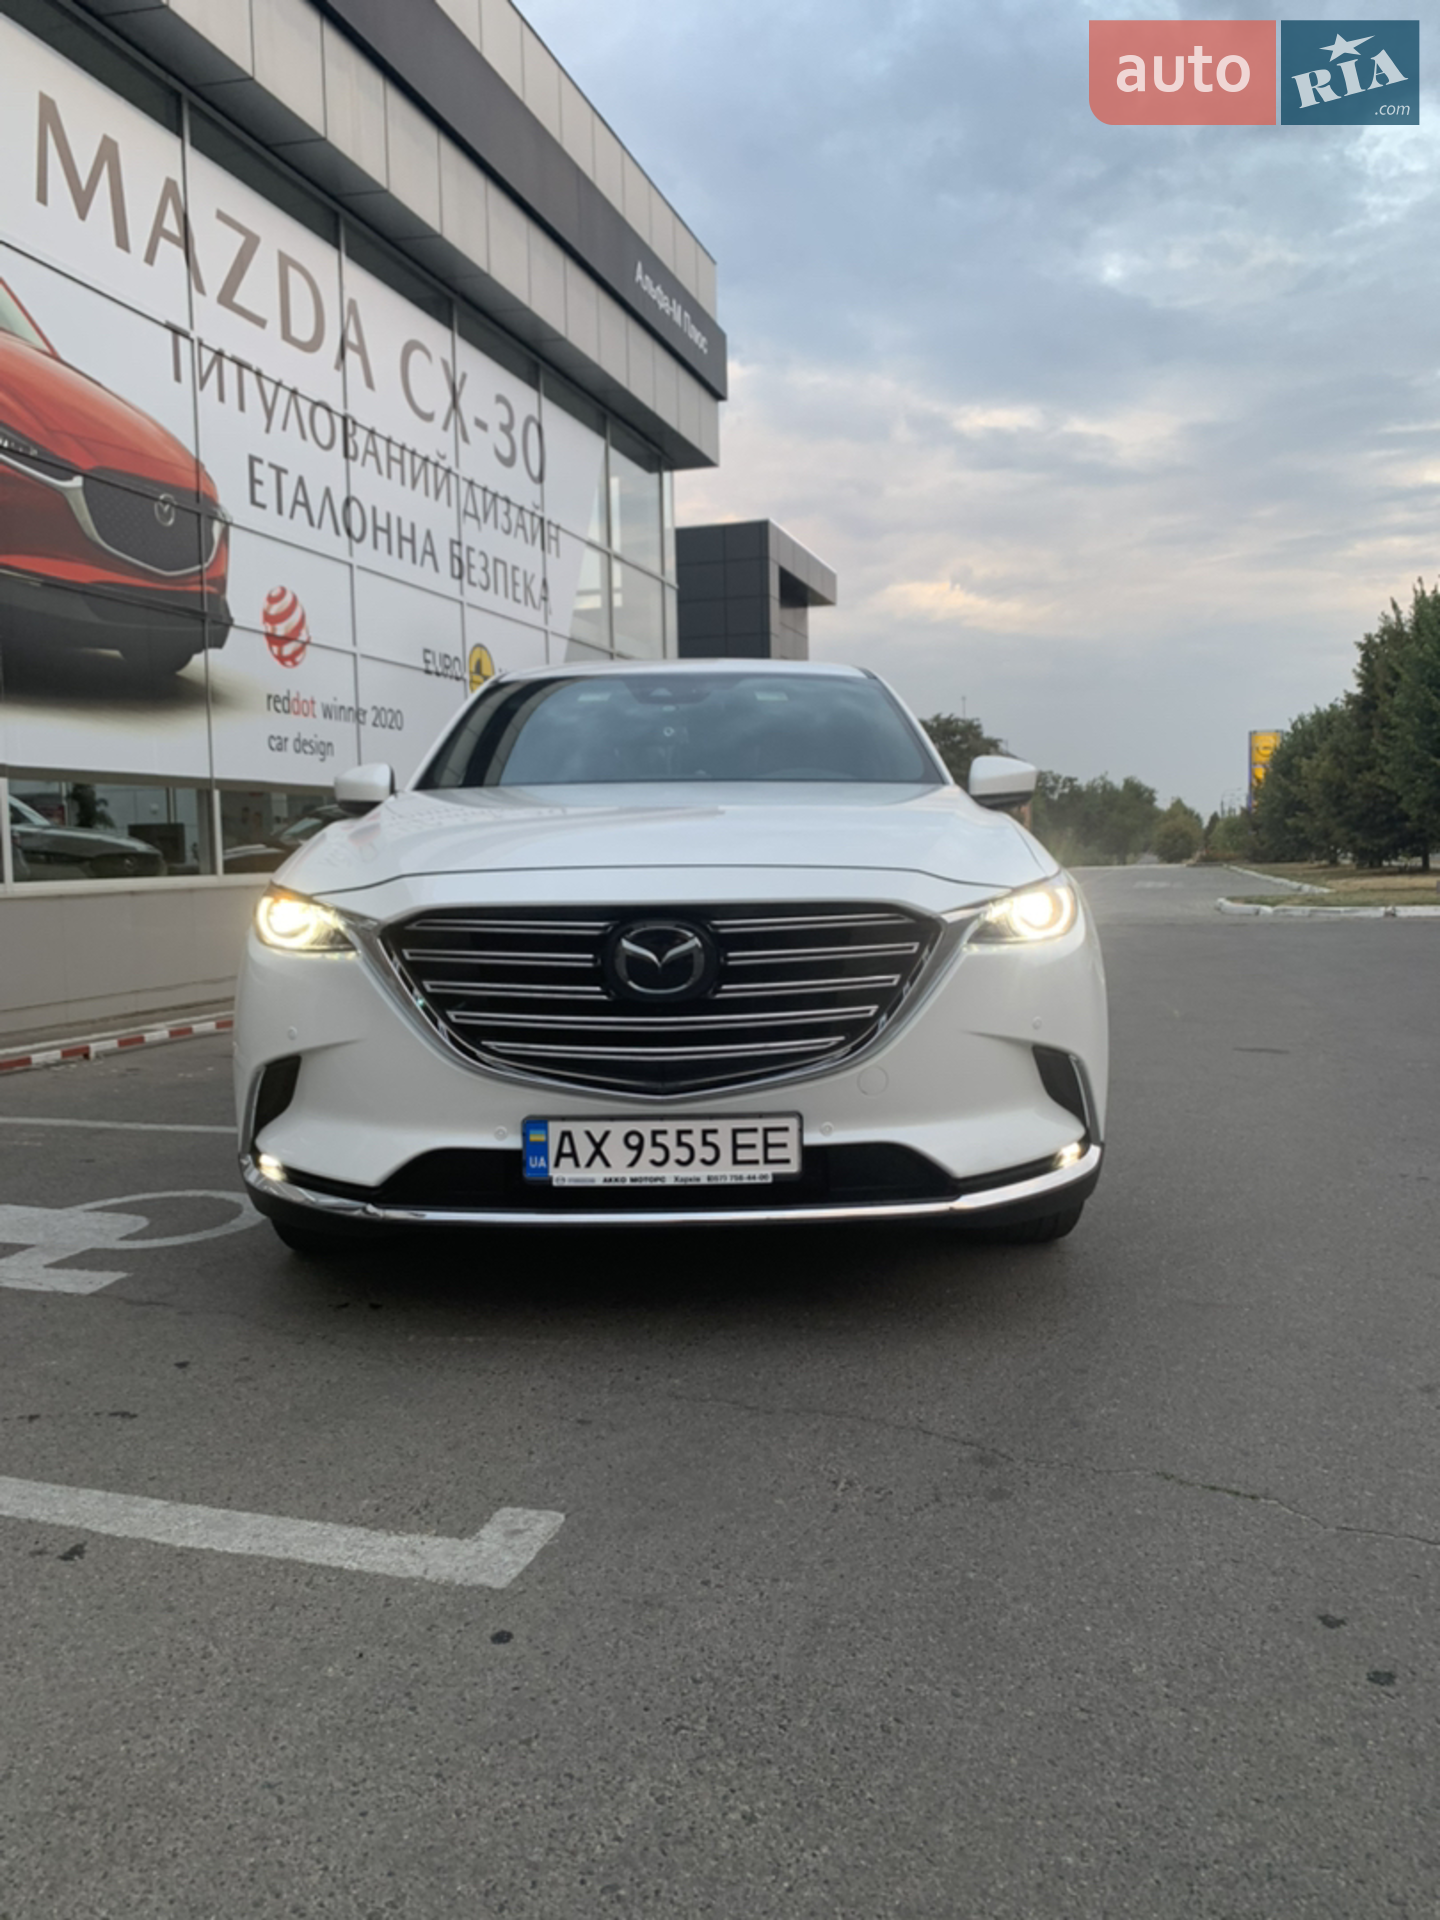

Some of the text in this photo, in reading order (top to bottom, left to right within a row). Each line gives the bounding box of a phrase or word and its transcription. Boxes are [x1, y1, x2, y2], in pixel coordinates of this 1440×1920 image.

[36, 90, 546, 485] MAZDA CX-30
[165, 320, 560, 559] ТИТУЛОВАНИЙ ДИЗАЙН
[248, 453, 552, 616] ЕТАЛОННА БЕЗПЕКА
[422, 647, 463, 682] EURO
[266, 689, 404, 731] reddot winner 2020
[267, 732, 334, 762] car design
[529, 1156, 548, 1169] UA
[553, 1126, 791, 1169] AX 9555 EE
